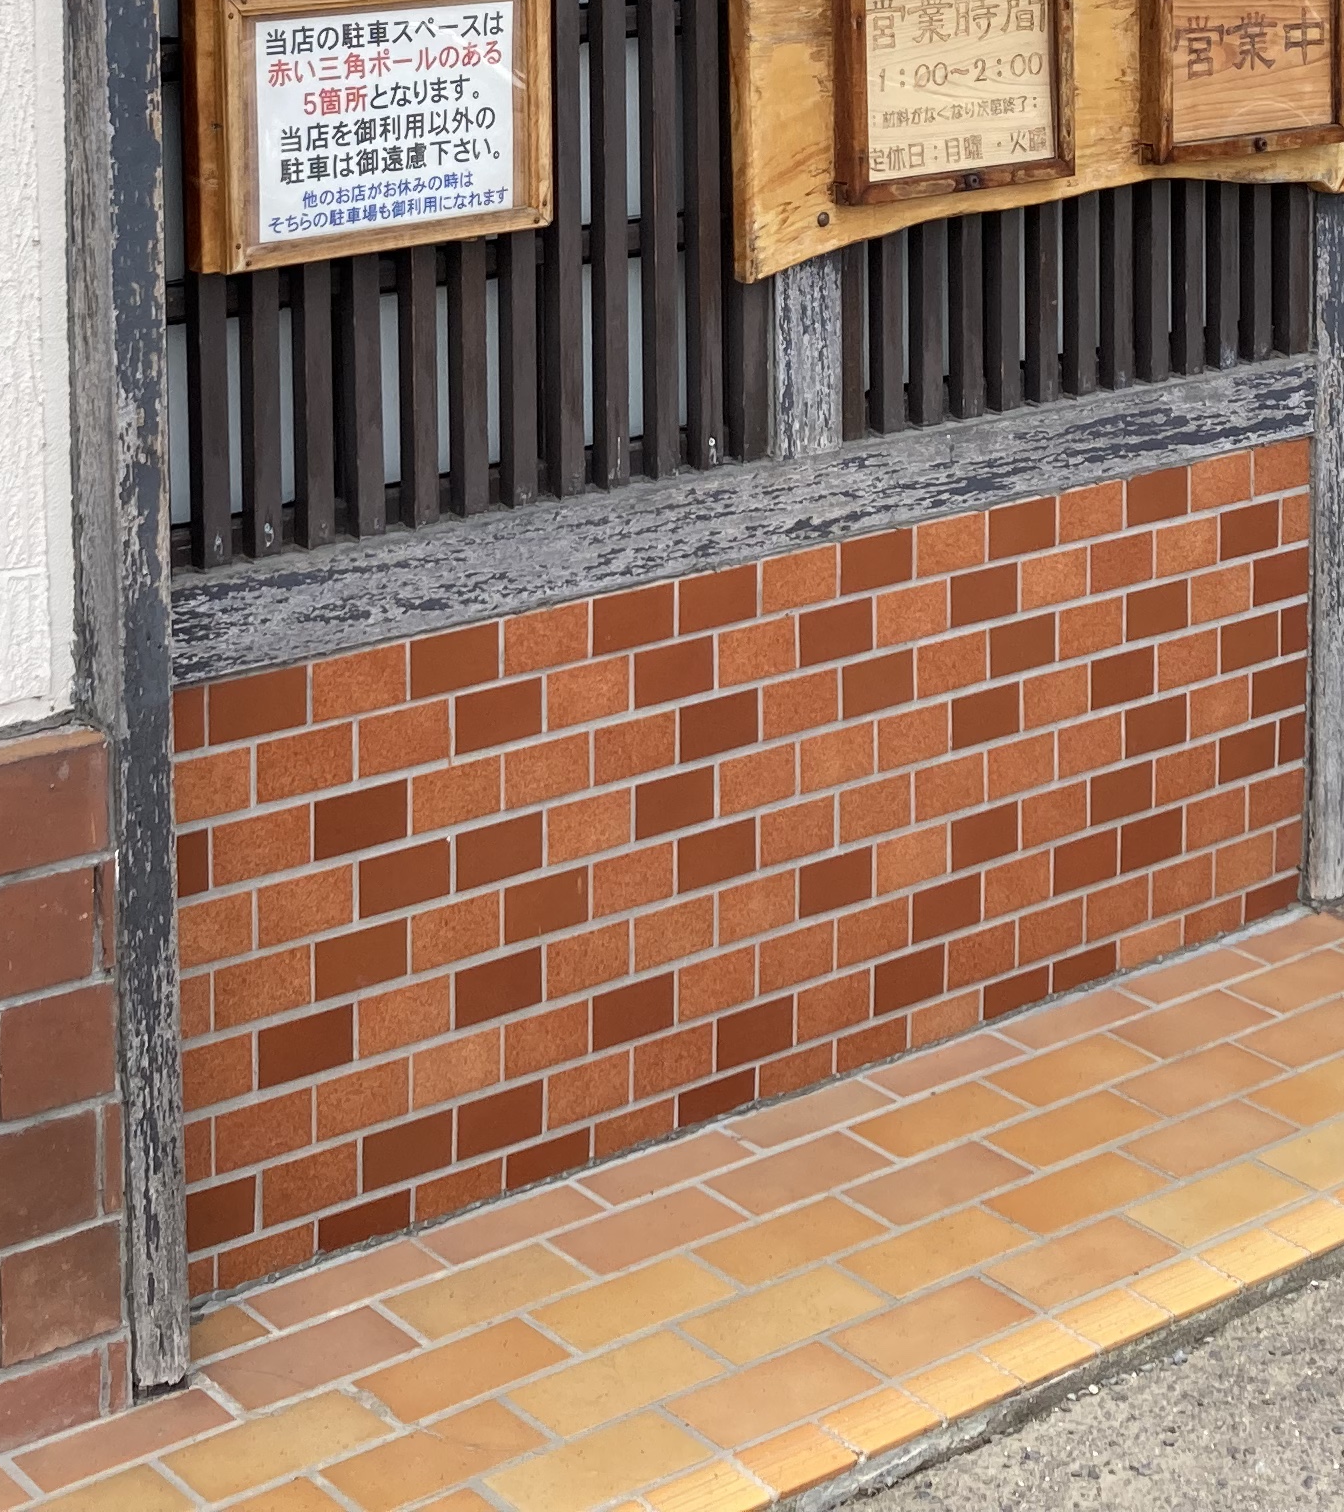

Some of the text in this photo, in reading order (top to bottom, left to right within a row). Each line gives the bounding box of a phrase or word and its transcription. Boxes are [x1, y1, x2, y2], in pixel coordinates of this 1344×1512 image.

[265, 11, 504, 55] 当店の駐車スペースは
[1173, 7, 1325, 80] 営業中
[268, 40, 502, 87] 赤い三角ポールのある
[304, 74, 480, 116] 5箇所となります。
[281, 106, 496, 153] 当店を御利用以外の
[280, 138, 501, 185] 駐車は御遠慮下さい。
[268, 186, 509, 233] そちらの駐車場も御利用になれます
[302, 171, 474, 209] 他のお店がお休みの時は
